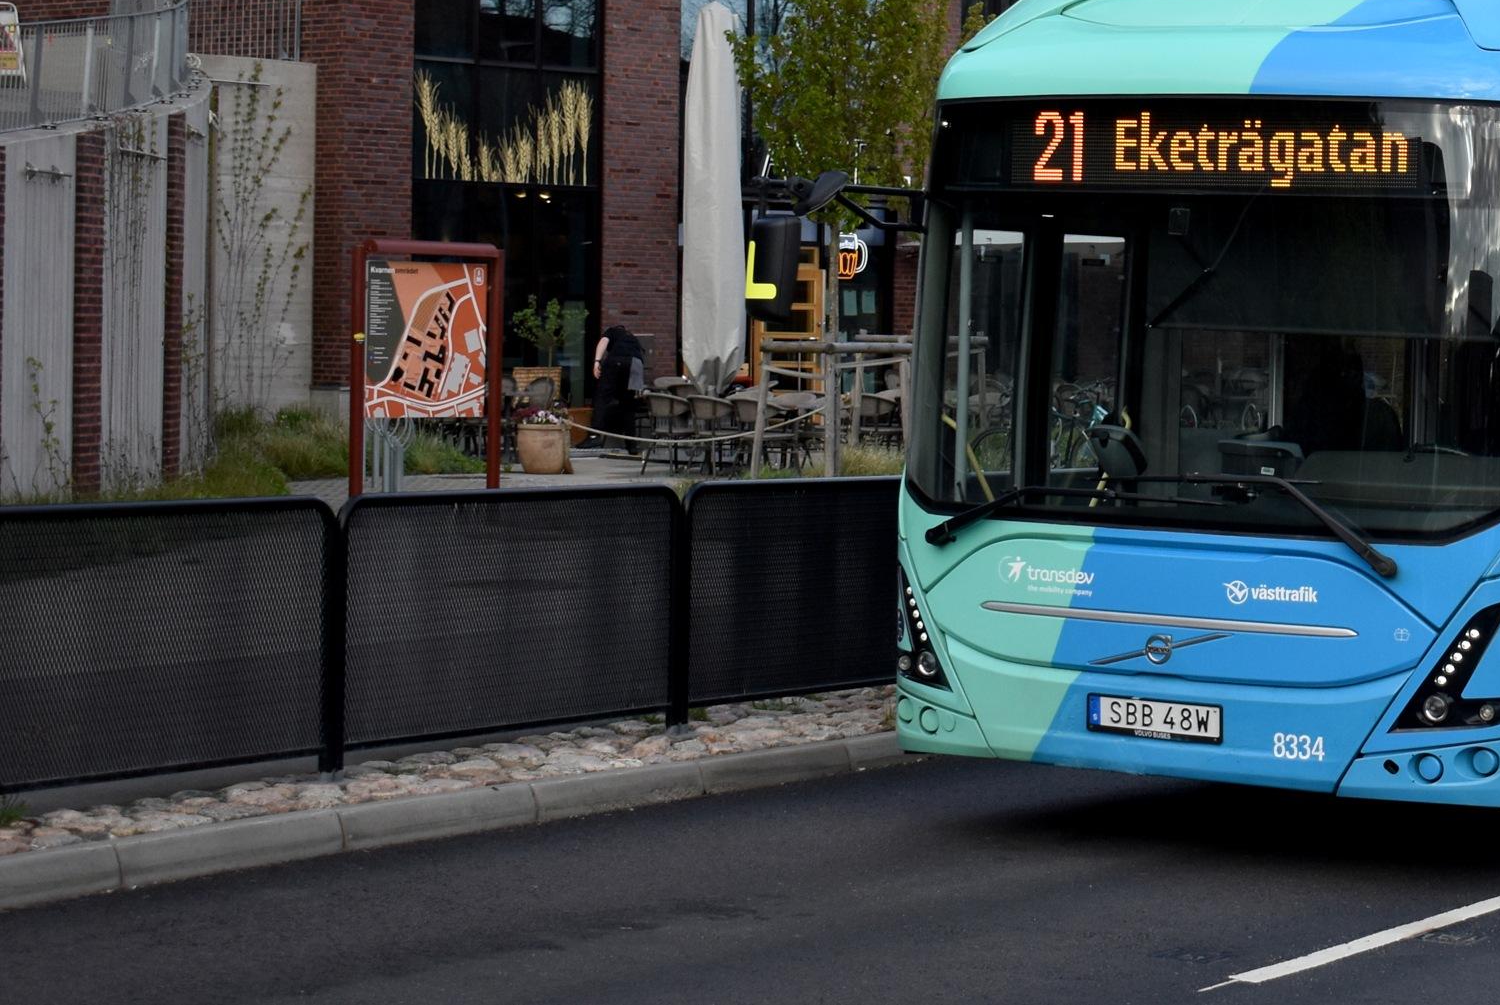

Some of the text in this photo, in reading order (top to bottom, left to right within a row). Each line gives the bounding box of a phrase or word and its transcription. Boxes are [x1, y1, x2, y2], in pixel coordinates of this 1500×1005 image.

[1034, 111, 1409, 188] 21 Eketrägatan
[1026, 564, 1095, 585] transdev
[1065, 588, 1093, 597] company
[1251, 584, 1318, 603] västtrafik
[1110, 700, 1210, 733] SBB 48W
[1134, 729, 1171, 740] VOLVO BUSES
[1273, 732, 1325, 762] 8334
